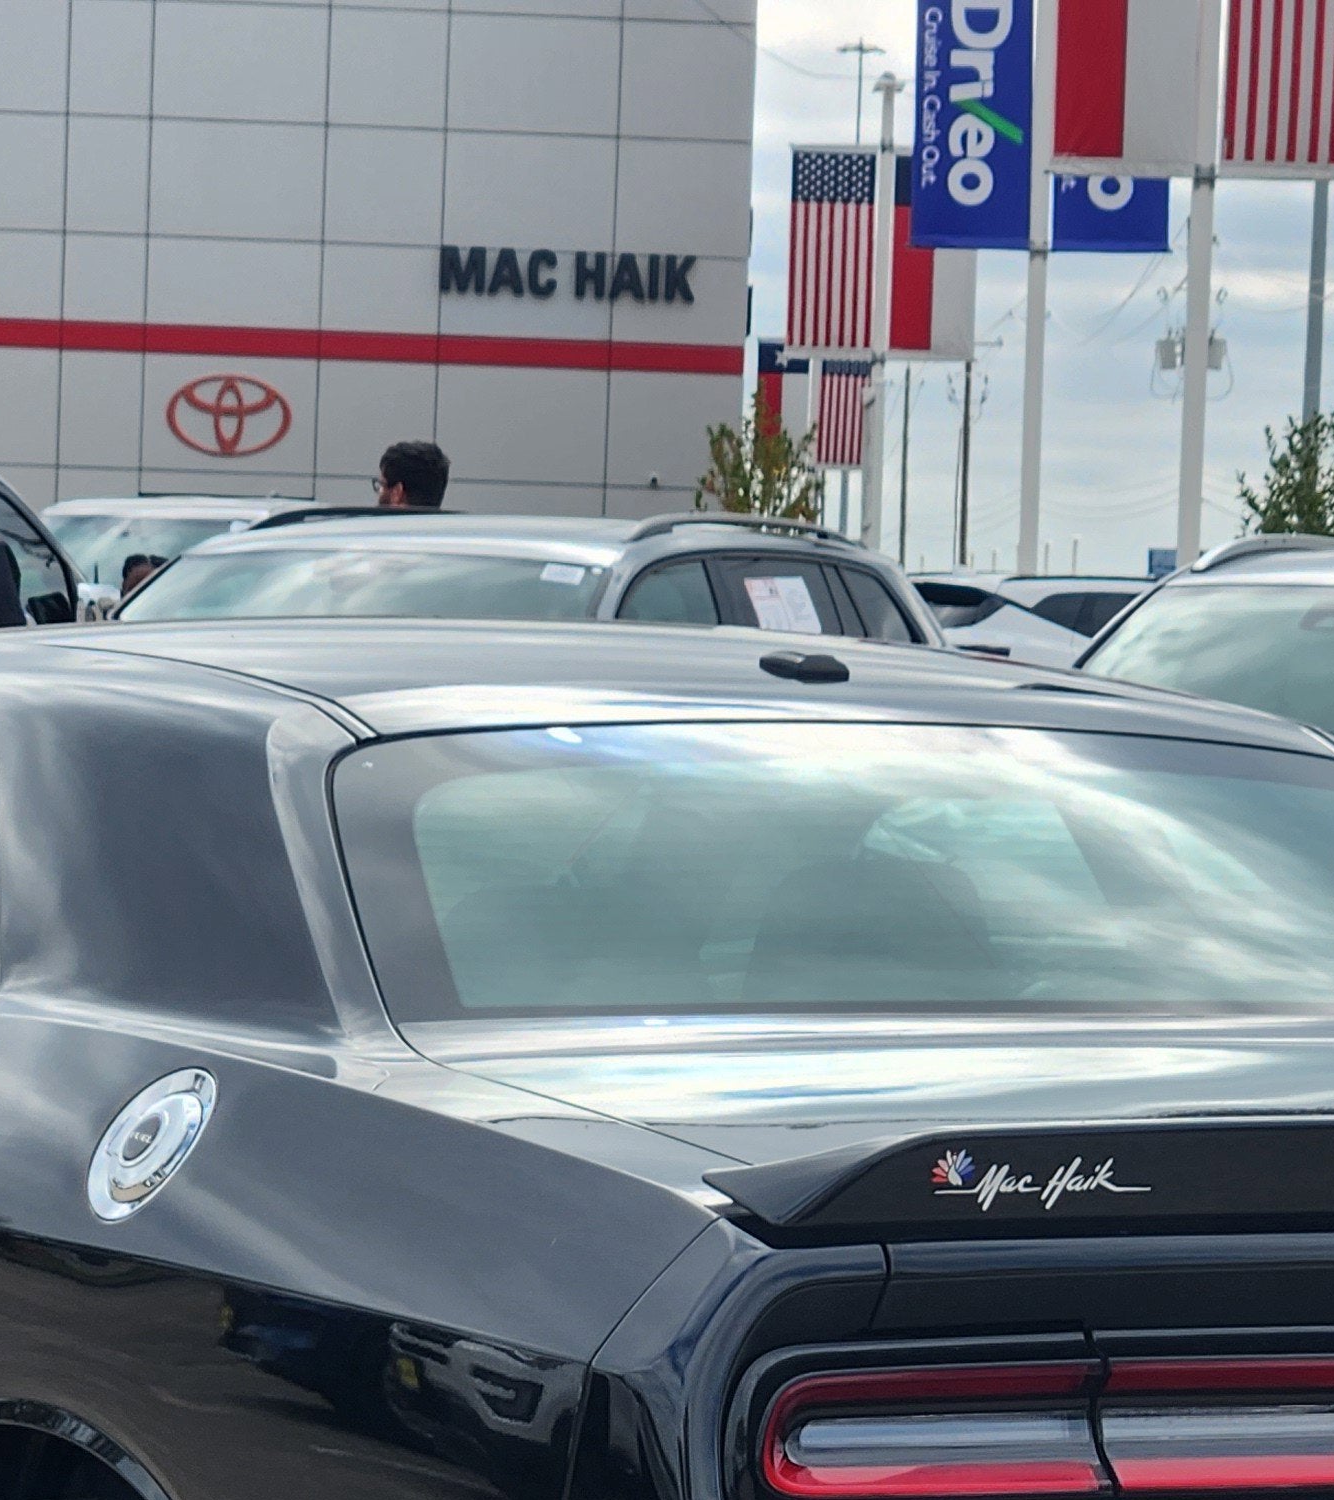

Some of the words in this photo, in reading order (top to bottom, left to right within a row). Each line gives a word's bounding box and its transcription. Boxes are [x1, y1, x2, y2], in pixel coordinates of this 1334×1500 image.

[923, 6, 943, 67] Cruise
[921, 94, 942, 143] Cash
[439, 244, 559, 300] MAC
[573, 251, 698, 306] HAIK
[967, 1163, 1041, 1212] Mac
[1040, 1156, 1151, 1210] Haik
